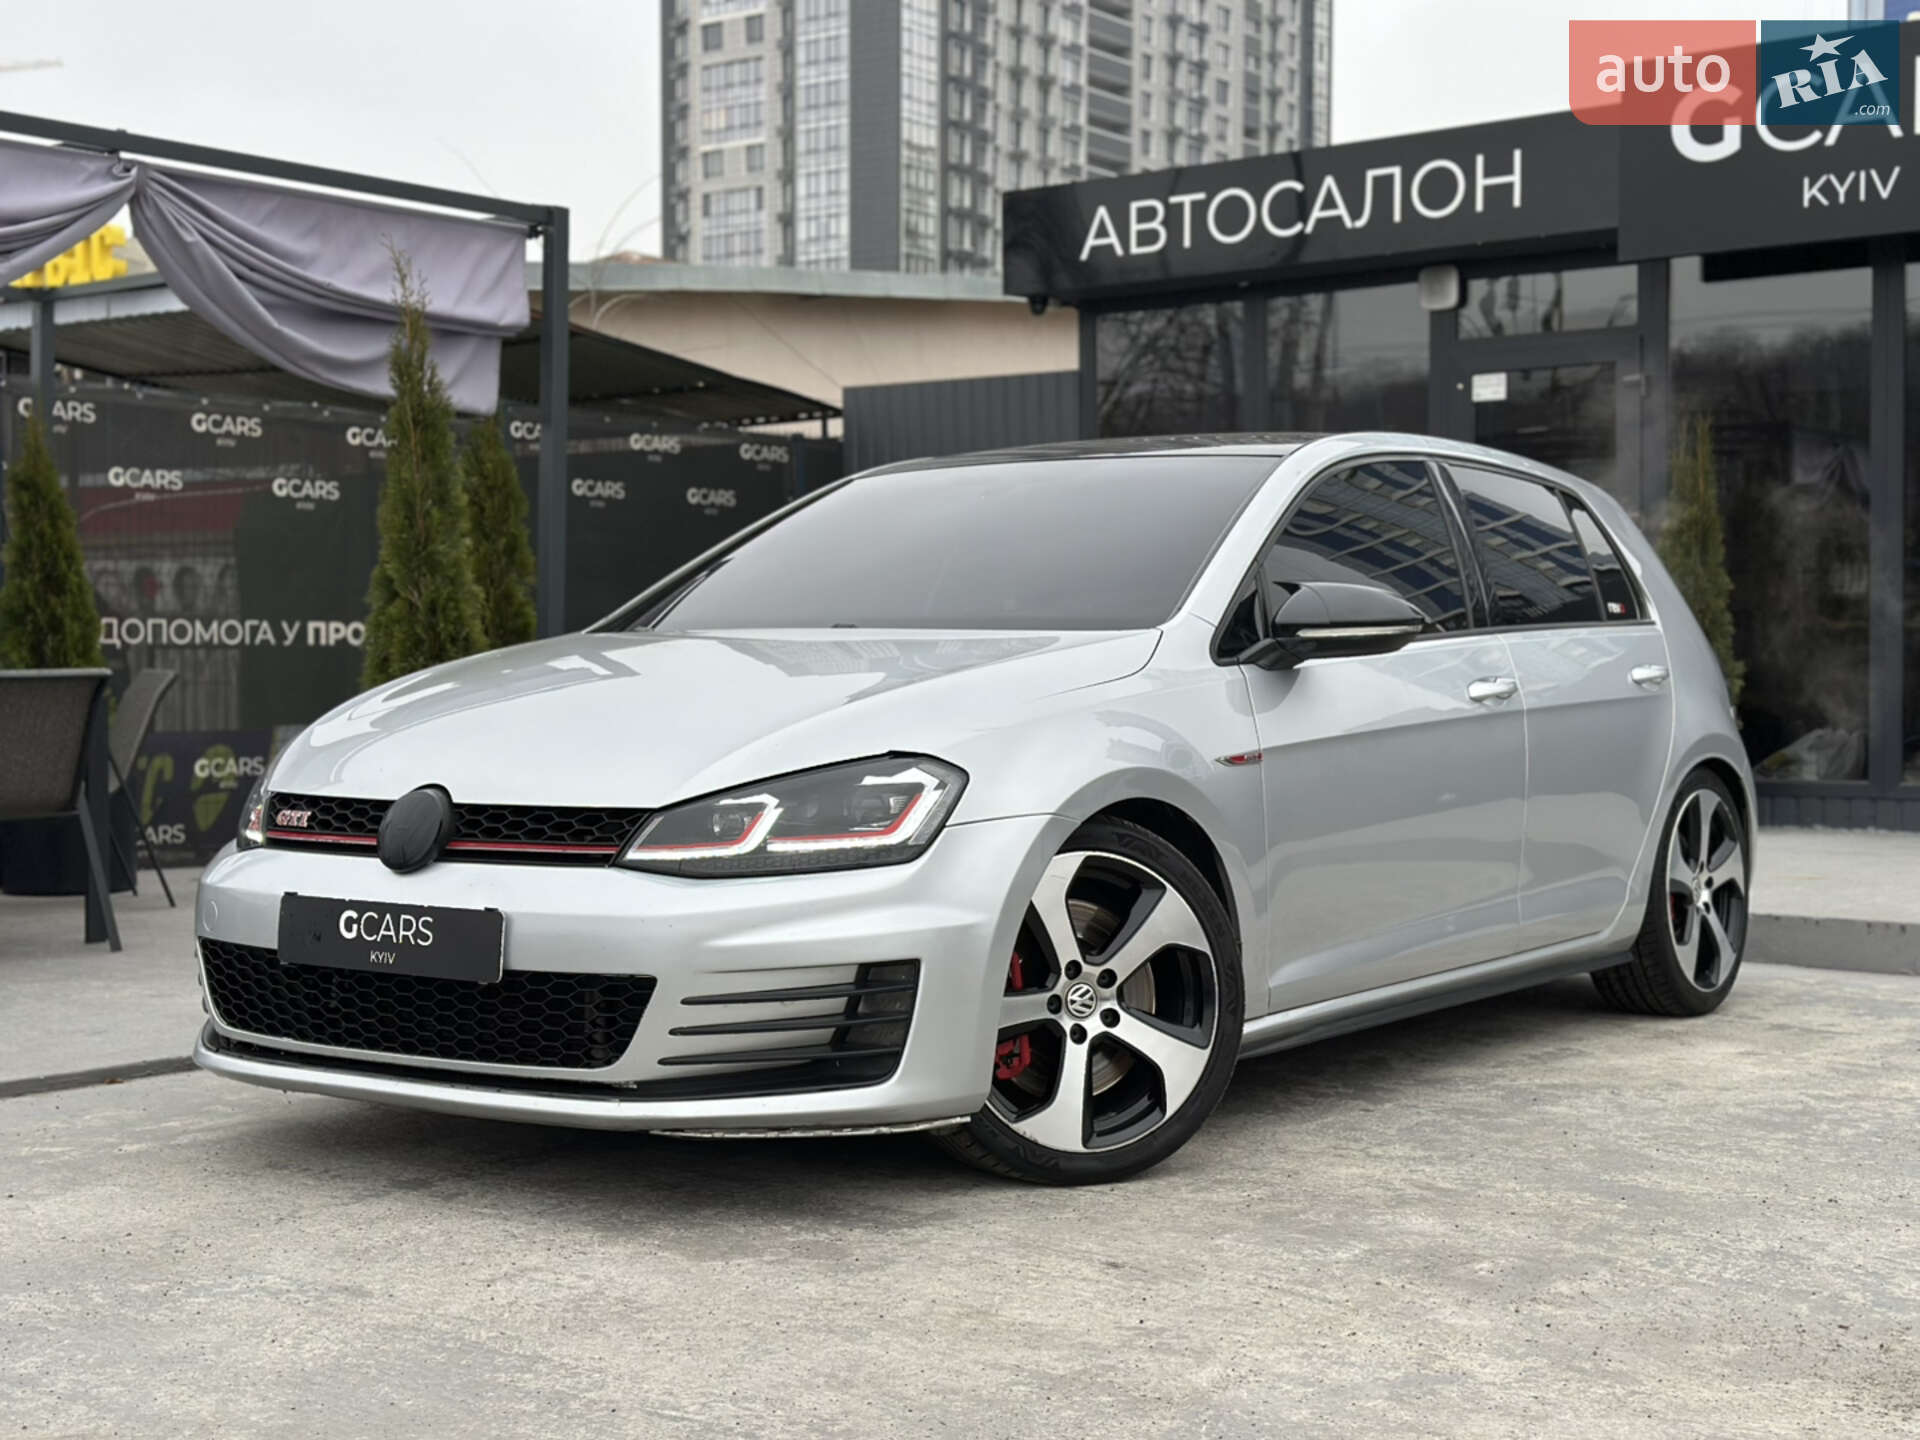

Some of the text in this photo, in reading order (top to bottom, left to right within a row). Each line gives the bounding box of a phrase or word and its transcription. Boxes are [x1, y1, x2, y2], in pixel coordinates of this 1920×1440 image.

[1670, 55, 1920, 163] GCA
[1803, 166, 1901, 208] KYIV
[1080, 149, 1523, 261] АВТОСАЛОН
[191, 412, 262, 437] GCARS
[346, 426, 398, 448] GCA
[630, 433, 681, 454] GCARS
[739, 443, 789, 463] GCARS
[108, 466, 183, 490] GCARS
[272, 477, 340, 500] GCARS
[571, 478, 626, 500] GCARS
[687, 487, 737, 507] GCARS
[99, 616, 277, 650] ДОПОМОГА
[280, 618, 301, 647] У
[194, 756, 264, 778] GCARS
[276, 809, 312, 828] GTI
[136, 823, 187, 845] ARS
[338, 909, 434, 946] GCARS
[369, 950, 397, 966] KYIV
